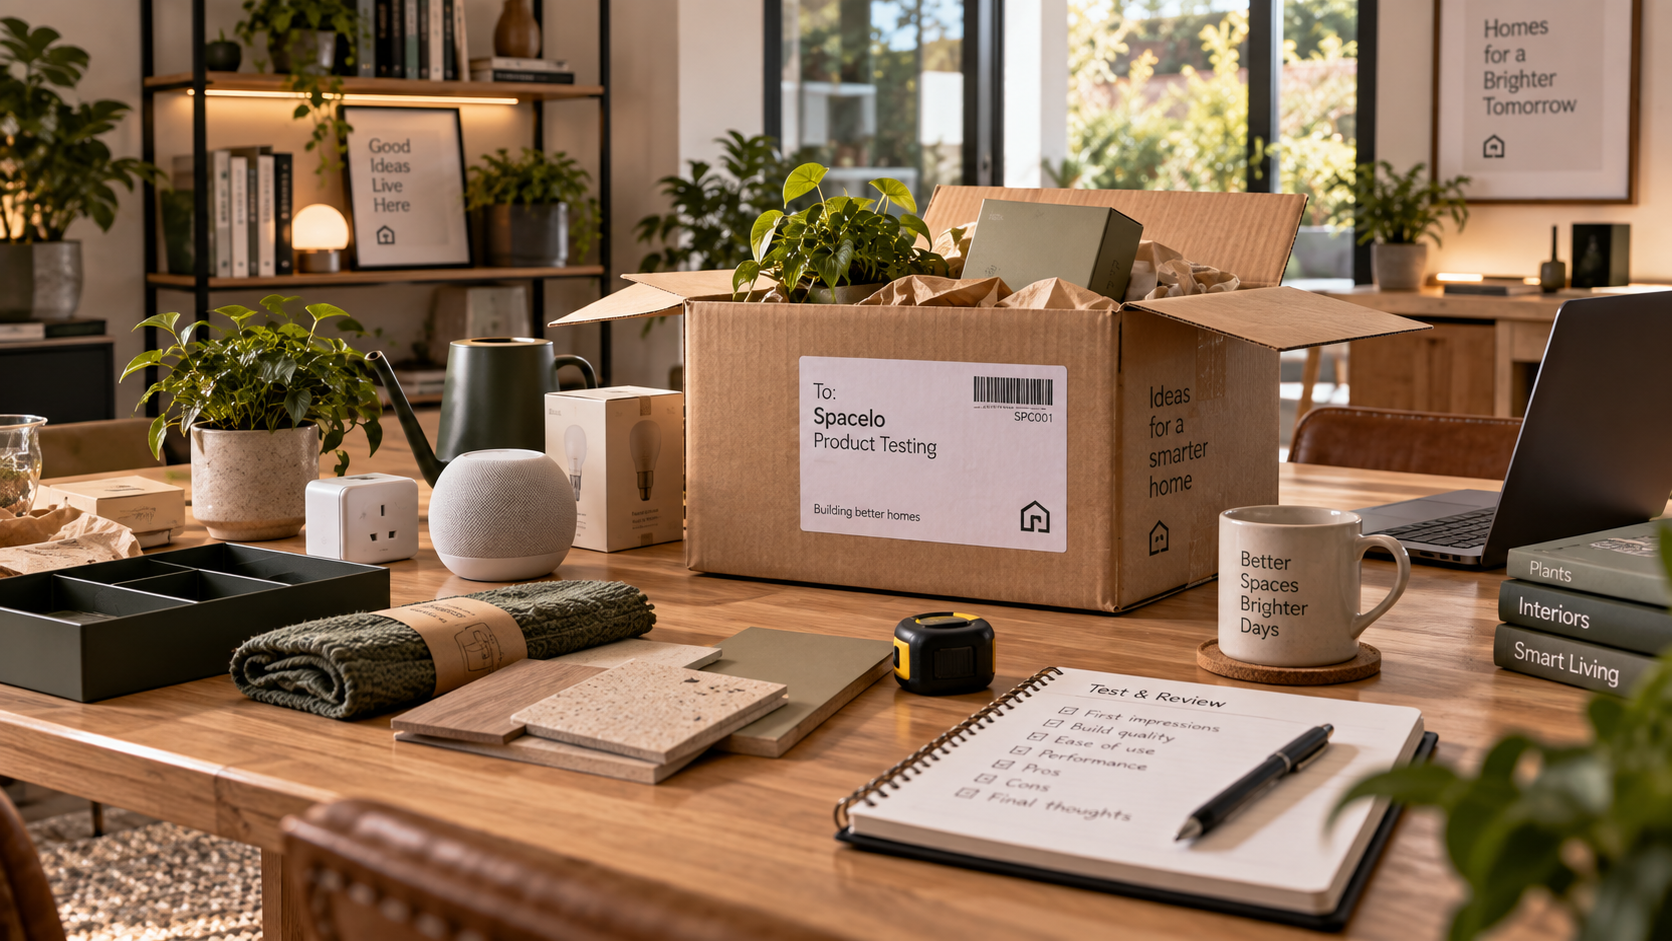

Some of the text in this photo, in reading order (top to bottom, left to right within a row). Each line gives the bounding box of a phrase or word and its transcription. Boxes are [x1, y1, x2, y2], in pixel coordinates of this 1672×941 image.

[1484, 18, 1549, 38] Homes
[1484, 44, 1526, 64] for a
[1483, 69, 1557, 94] Brighter
[1483, 96, 1577, 115] Tomorrow
[368, 137, 411, 154] Good
[370, 157, 411, 173] Ideas
[372, 177, 403, 193] Live
[373, 197, 411, 213] Here
[813, 382, 836, 400] To:
[1149, 385, 1191, 409] Ideas
[813, 406, 886, 429] Spacelo
[1014, 411, 1053, 423] SPC001
[1149, 416, 1185, 438] for a
[813, 432, 937, 459] Product Testing
[1149, 440, 1208, 468] smarter
[1149, 474, 1193, 498] home
[813, 503, 921, 522] Building better homes
[1240, 550, 1291, 571] Better
[1529, 560, 1572, 582] Plants
[1240, 573, 1299, 593] Spaces
[1240, 595, 1308, 618] Brighter
[1518, 596, 1590, 629] Interiors
[1240, 617, 1279, 640] Days
[1514, 641, 1620, 688] Smart Living
[1088, 683, 1227, 709] Test & Review
[1084, 709, 1220, 733] First impressions
[1070, 722, 1175, 744] Build quality
[1054, 736, 1155, 756] Ease of use
[1022, 763, 1061, 778] Pros
[1039, 749, 1148, 772] Performance
[1006, 778, 1051, 793] Cons
[987, 791, 1132, 822] Final thoughts
